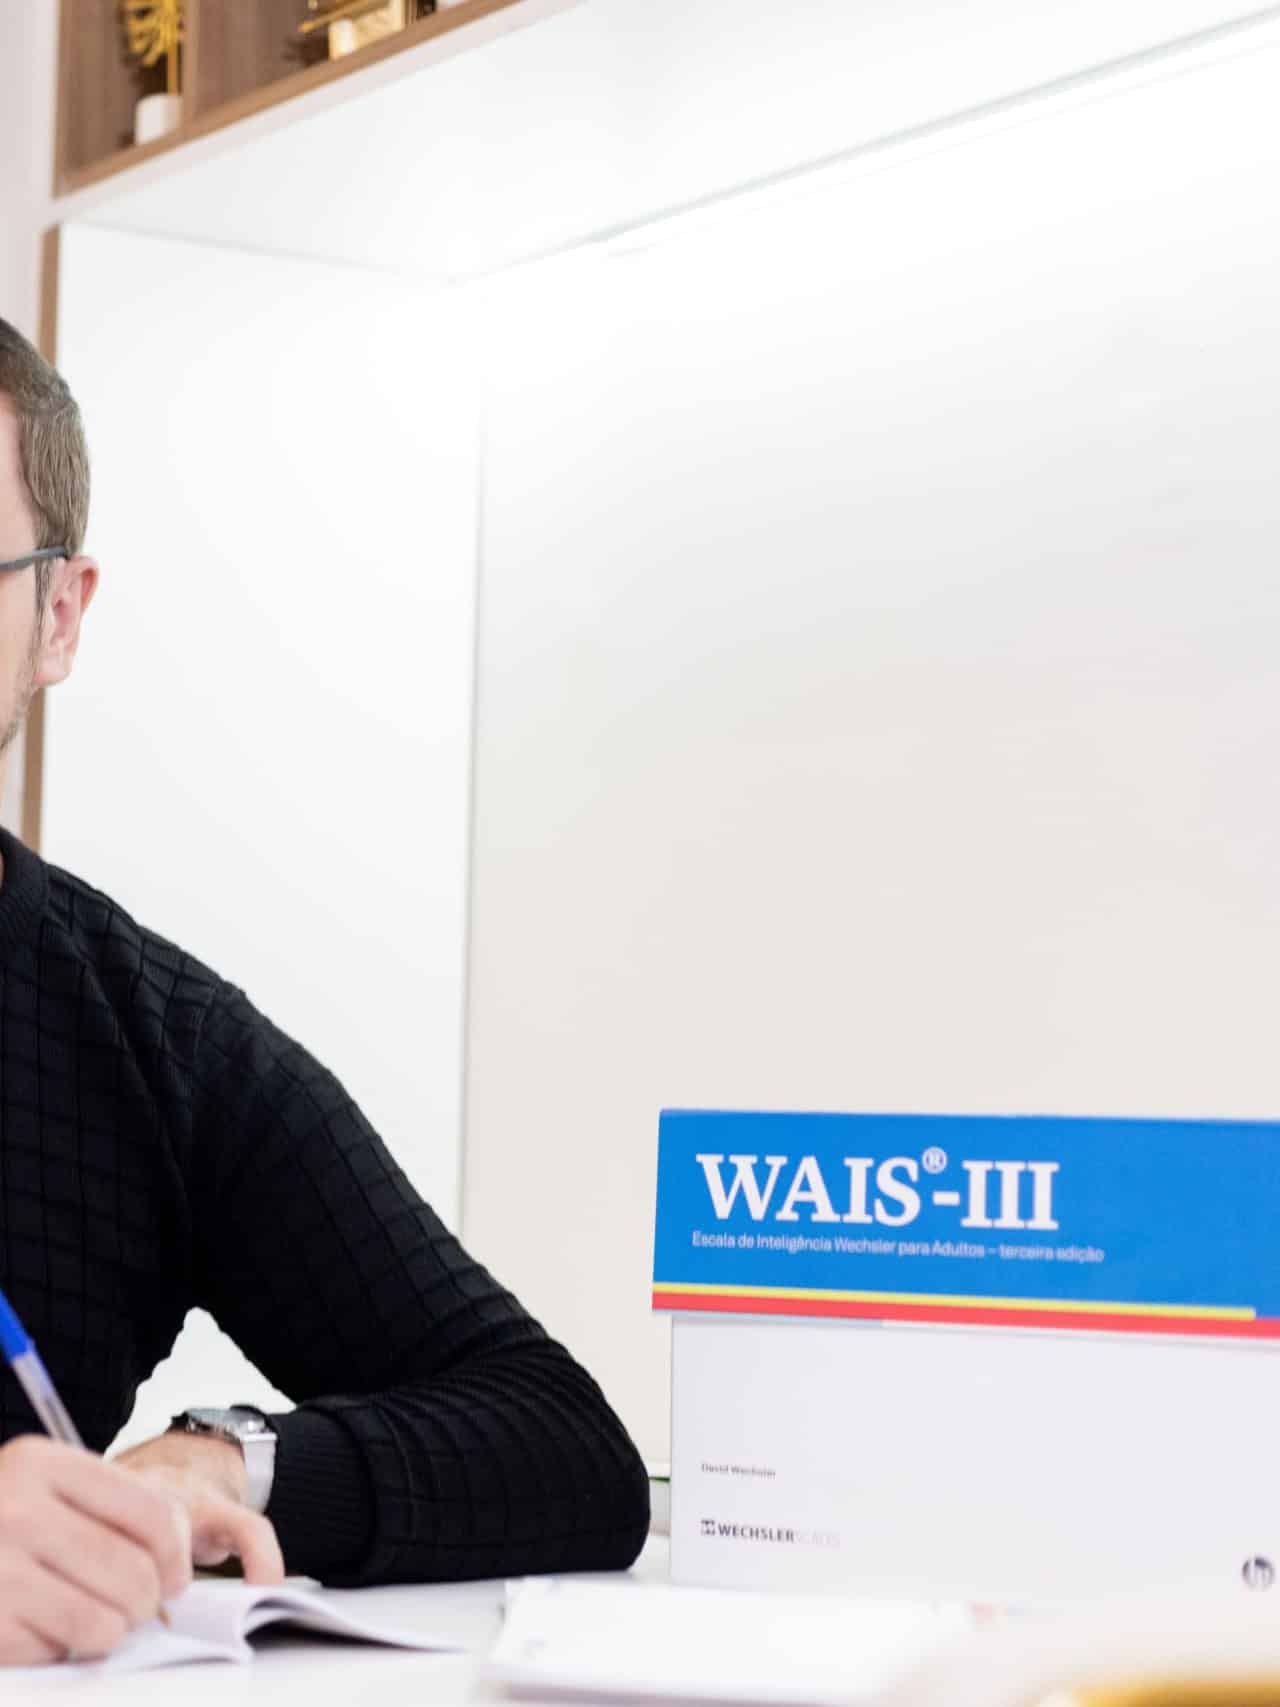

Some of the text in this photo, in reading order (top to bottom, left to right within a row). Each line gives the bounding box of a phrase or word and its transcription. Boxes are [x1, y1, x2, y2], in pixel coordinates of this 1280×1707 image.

[692, 1230, 735, 1248] Escala
[737, 1232, 755, 1249] de
[757, 1232, 832, 1255] Inteligência
[834, 1236, 896, 1255] Wechsler
[898, 1241, 929, 1258] para
[931, 1239, 985, 1259] Adultos
[1000, 1242, 1054, 1261] terceira
[1056, 1243, 1105, 1265] edição
